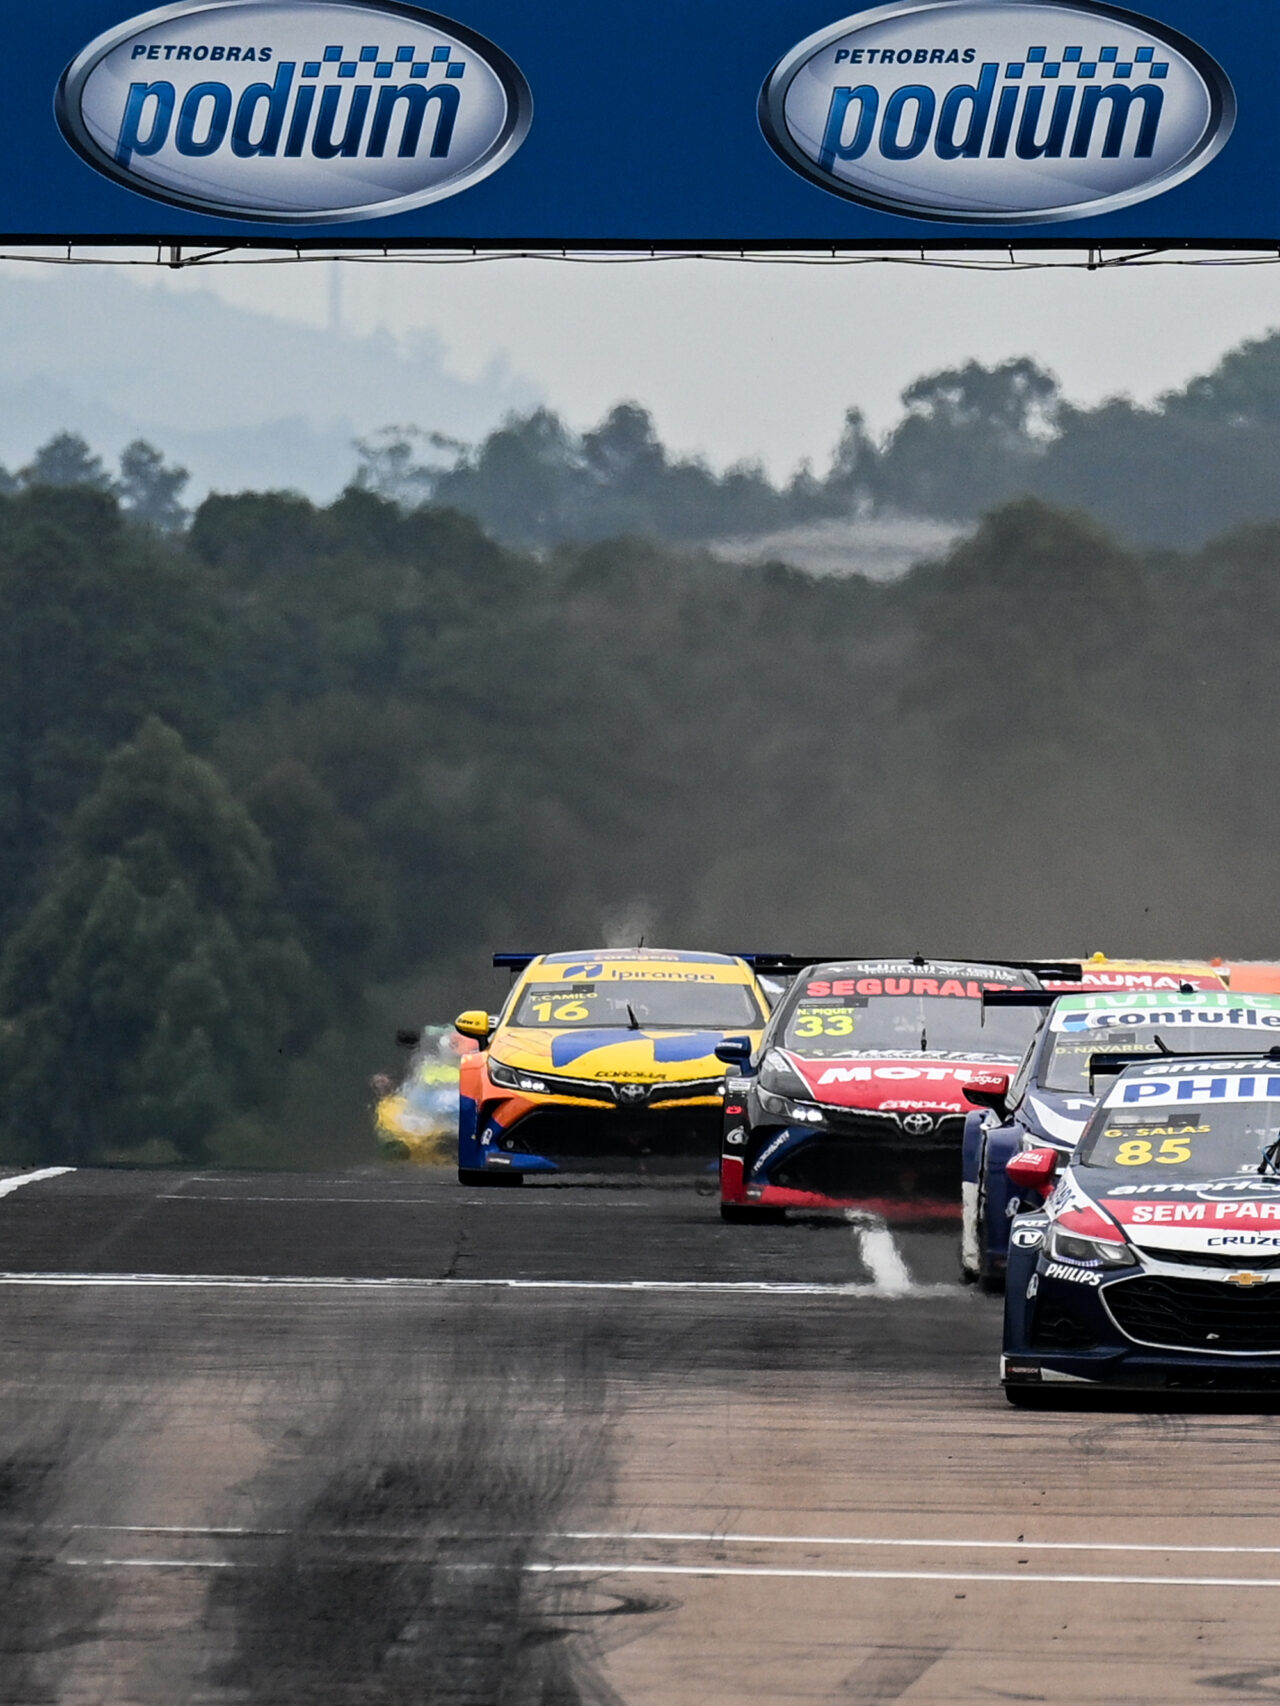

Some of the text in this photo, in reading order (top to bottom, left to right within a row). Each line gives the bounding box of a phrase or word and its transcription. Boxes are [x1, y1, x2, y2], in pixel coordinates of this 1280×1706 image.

[130, 45, 273, 62] PETROBRAS
[834, 48, 976, 64] PETROBRAS
[115, 62, 461, 169] podium
[818, 63, 1165, 173] podium
[612, 968, 715, 982] Ipiranga
[806, 978, 1026, 998] SEGURAL
[531, 1001, 589, 1022] 16
[812, 1008, 855, 1016] PIQUET
[794, 1016, 854, 1038] 33
[1077, 1043, 1157, 1053] NAVARRO
[594, 1070, 667, 1081] COROLLA
[817, 1066, 1014, 1085] MOTU
[879, 1099, 962, 1112] COROLLA
[1136, 1125, 1211, 1137] SALAS
[1114, 1138, 1192, 1165] 85
[1132, 1203, 1205, 1223] SEM
[1045, 1263, 1103, 1286] PHILIPS
